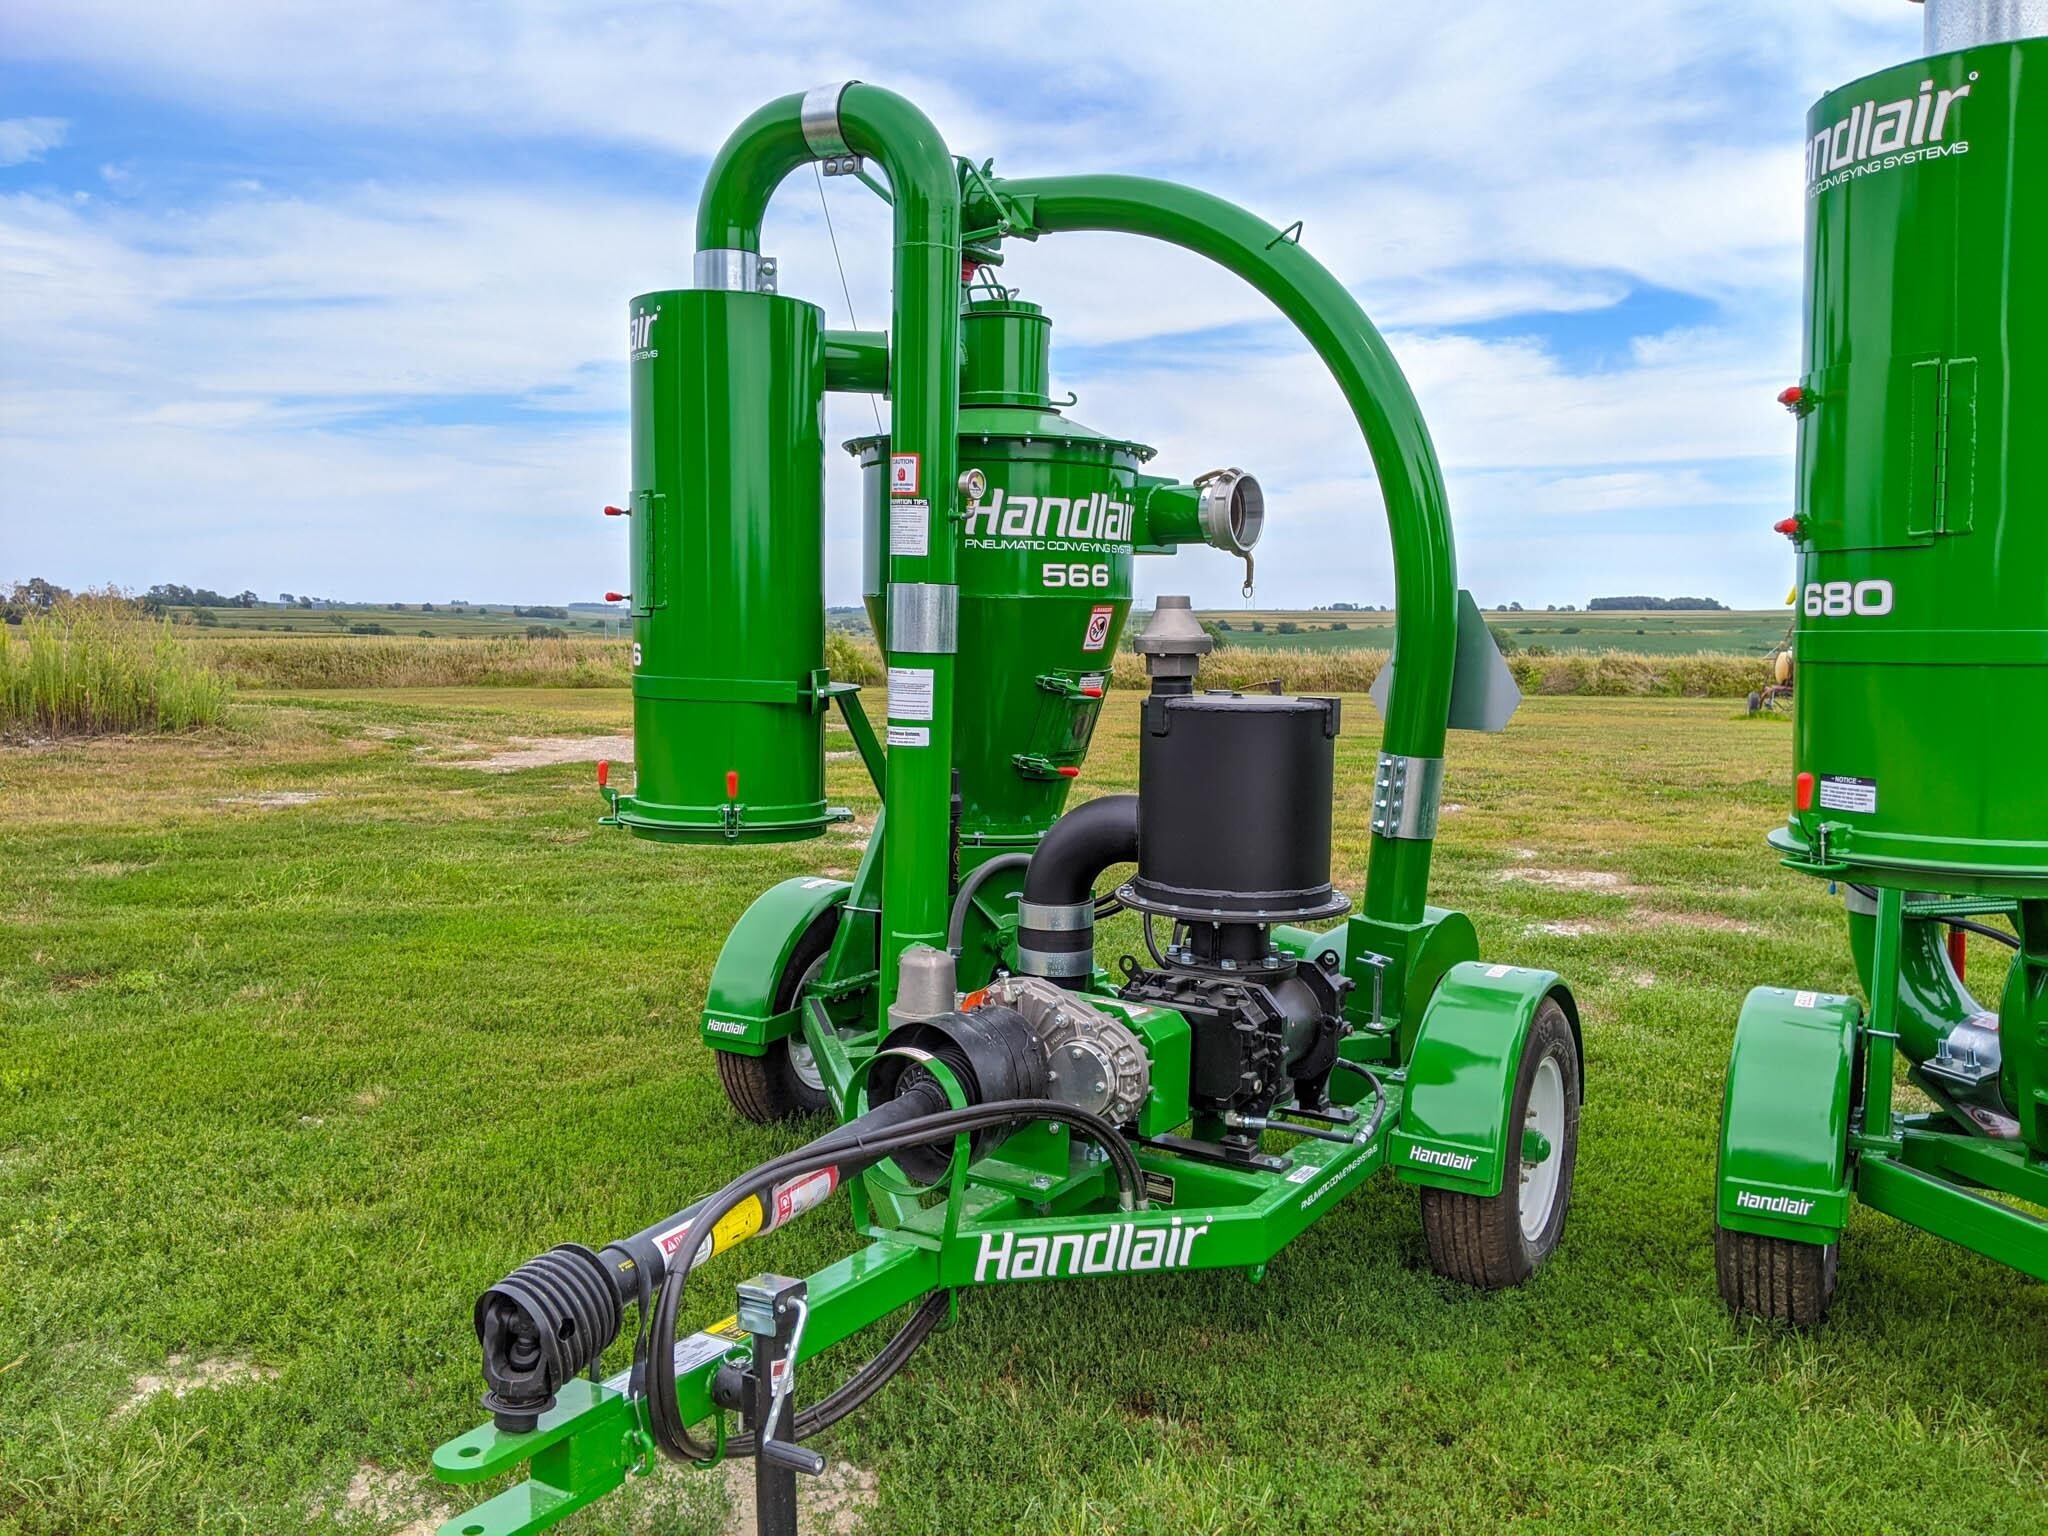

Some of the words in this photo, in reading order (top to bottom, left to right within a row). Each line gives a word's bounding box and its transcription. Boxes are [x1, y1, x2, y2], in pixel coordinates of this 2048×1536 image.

[1816, 160, 1881, 194] CONVEYING
[1884, 141, 1968, 169] SYSTEMS
[965, 488, 1135, 541] Handlair
[965, 539, 1045, 551] PNEUMATIC
[1047, 541, 1111, 553] CONVEYING
[1042, 564, 1109, 587] 566
[1804, 580, 1893, 616] 680
[1834, 775, 1857, 784] NOTICE
[707, 1018, 748, 1035] Handlair
[1409, 1145, 1477, 1171] Handlair
[1301, 1181, 1330, 1212] PNEUMATIC
[1330, 1160, 1357, 1187] CONVEYING
[1737, 1190, 1814, 1216] Handlair
[974, 1217, 1208, 1281] Handlair
